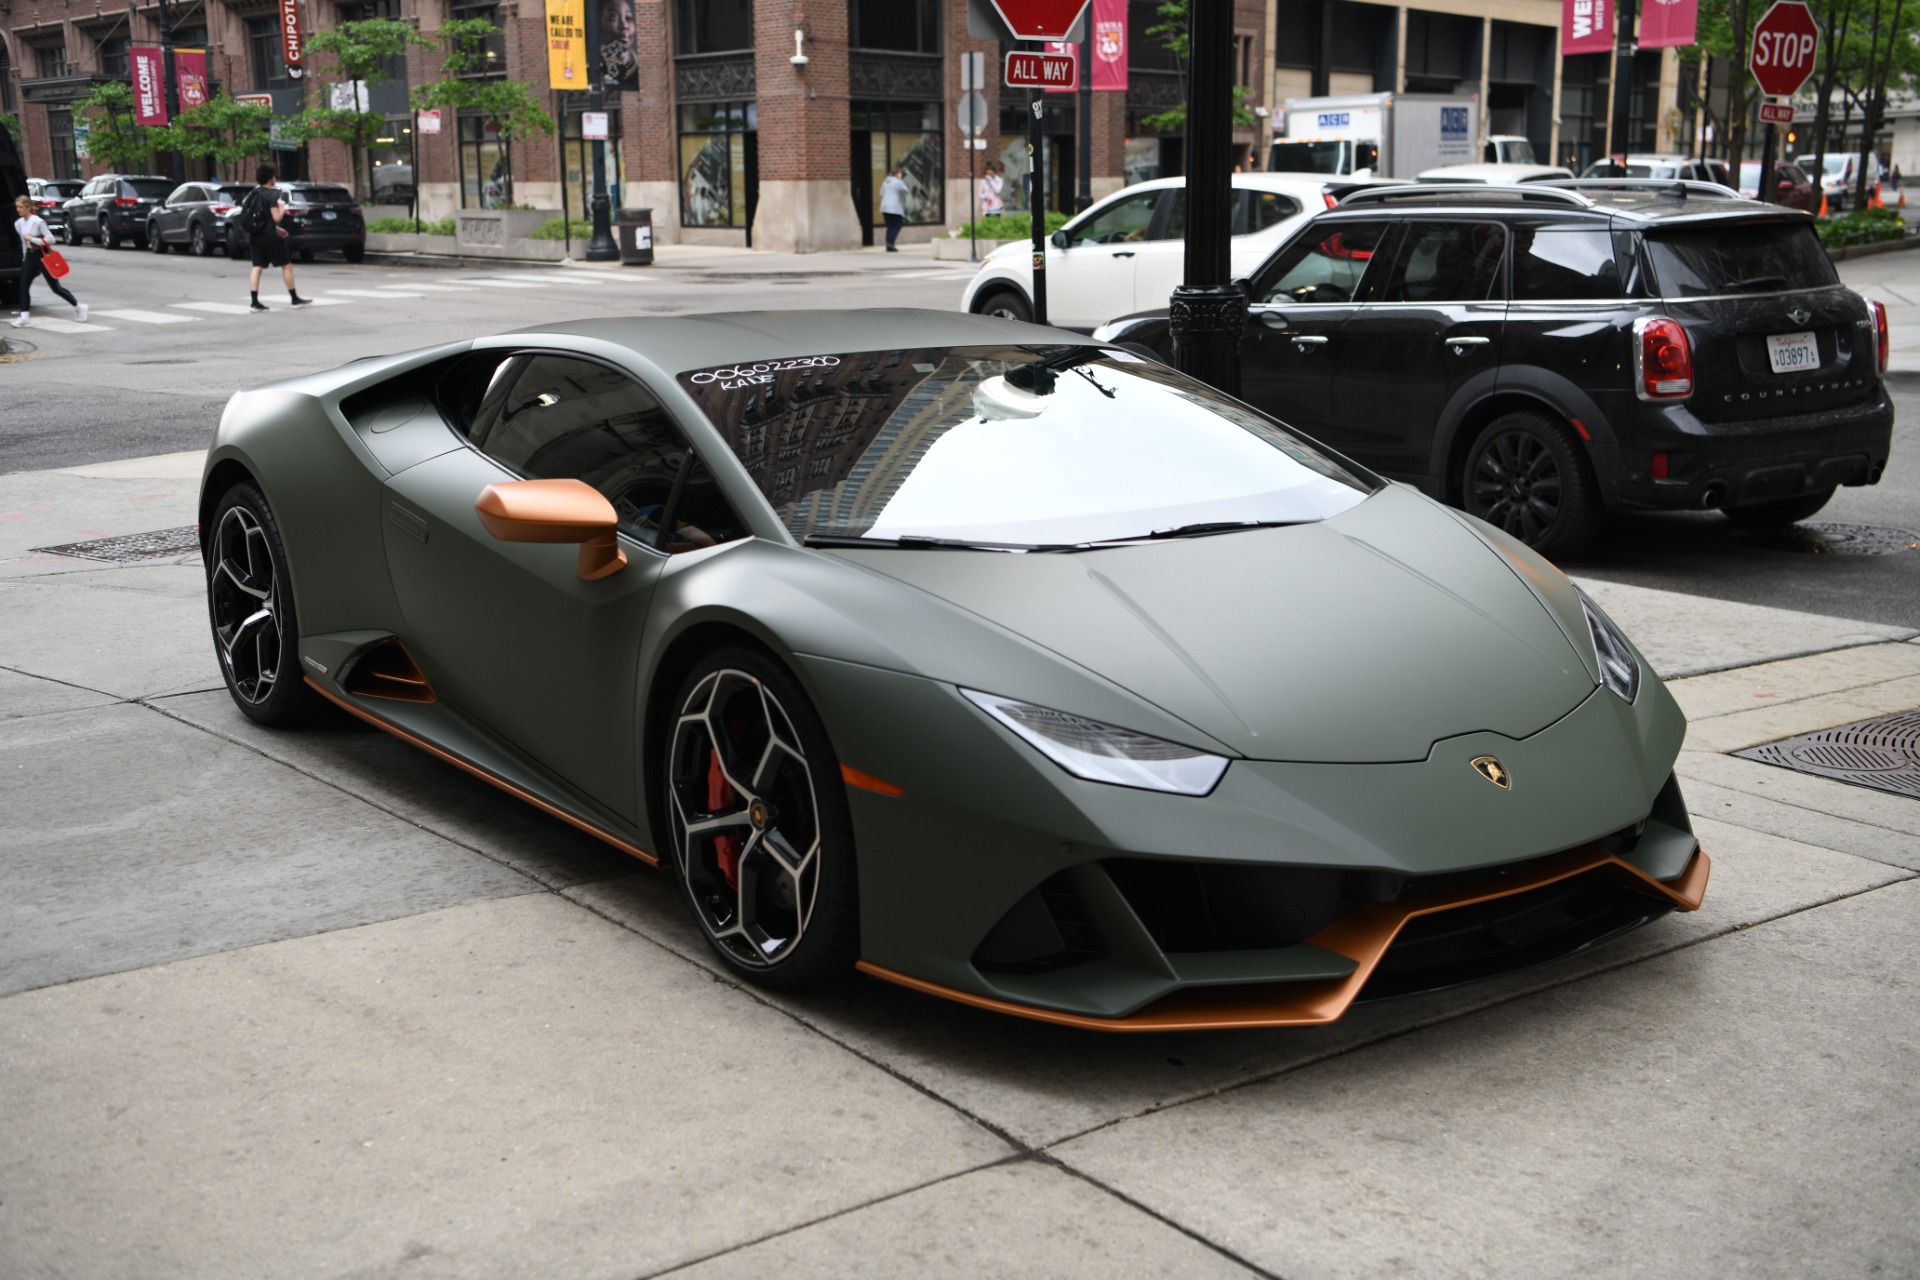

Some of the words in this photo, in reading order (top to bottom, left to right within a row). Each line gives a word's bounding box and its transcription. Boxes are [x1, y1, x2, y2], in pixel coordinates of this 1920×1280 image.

[285, 0, 300, 61] CHIPOTL
[1755, 31, 1814, 68] STOP
[1013, 59, 1038, 79] ALL
[1043, 61, 1069, 81] WAY
[136, 55, 154, 118] WELCOME
[1762, 107, 1776, 119] ALL
[1777, 108, 1792, 120] WAY
[1778, 346, 1809, 366] 03897
[720, 374, 775, 391] KANE
[1723, 379, 1862, 402] COUNTRYMAN
